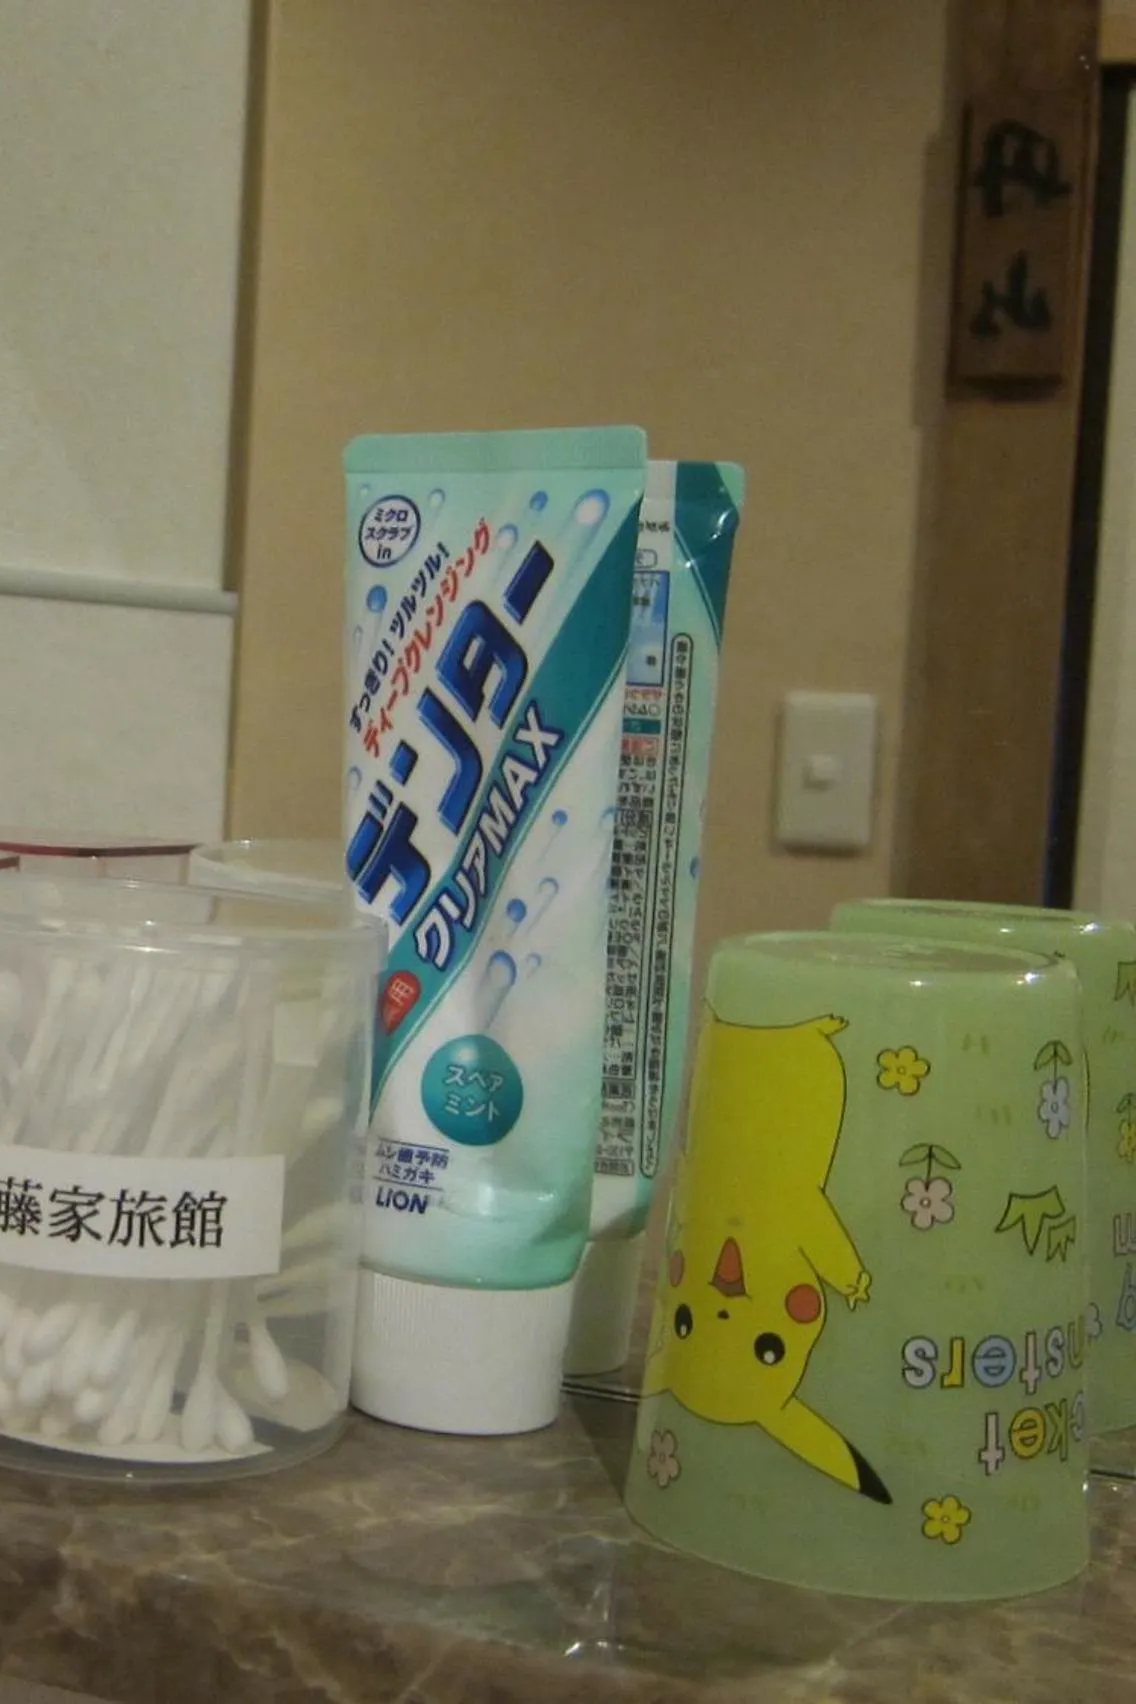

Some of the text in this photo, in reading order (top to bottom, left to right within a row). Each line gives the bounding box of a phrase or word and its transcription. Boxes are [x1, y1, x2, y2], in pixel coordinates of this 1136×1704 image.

[373, 506, 408, 524] ミクロ
[365, 523, 410, 543] スクラブ
[376, 541, 392, 560] in
[362, 517, 493, 760] ディープクレンジング
[444, 1063, 505, 1090] スペア
[442, 1093, 501, 1123] ミント
[378, 1163, 436, 1184] ハミガキ
[375, 1186, 429, 1214] LION
